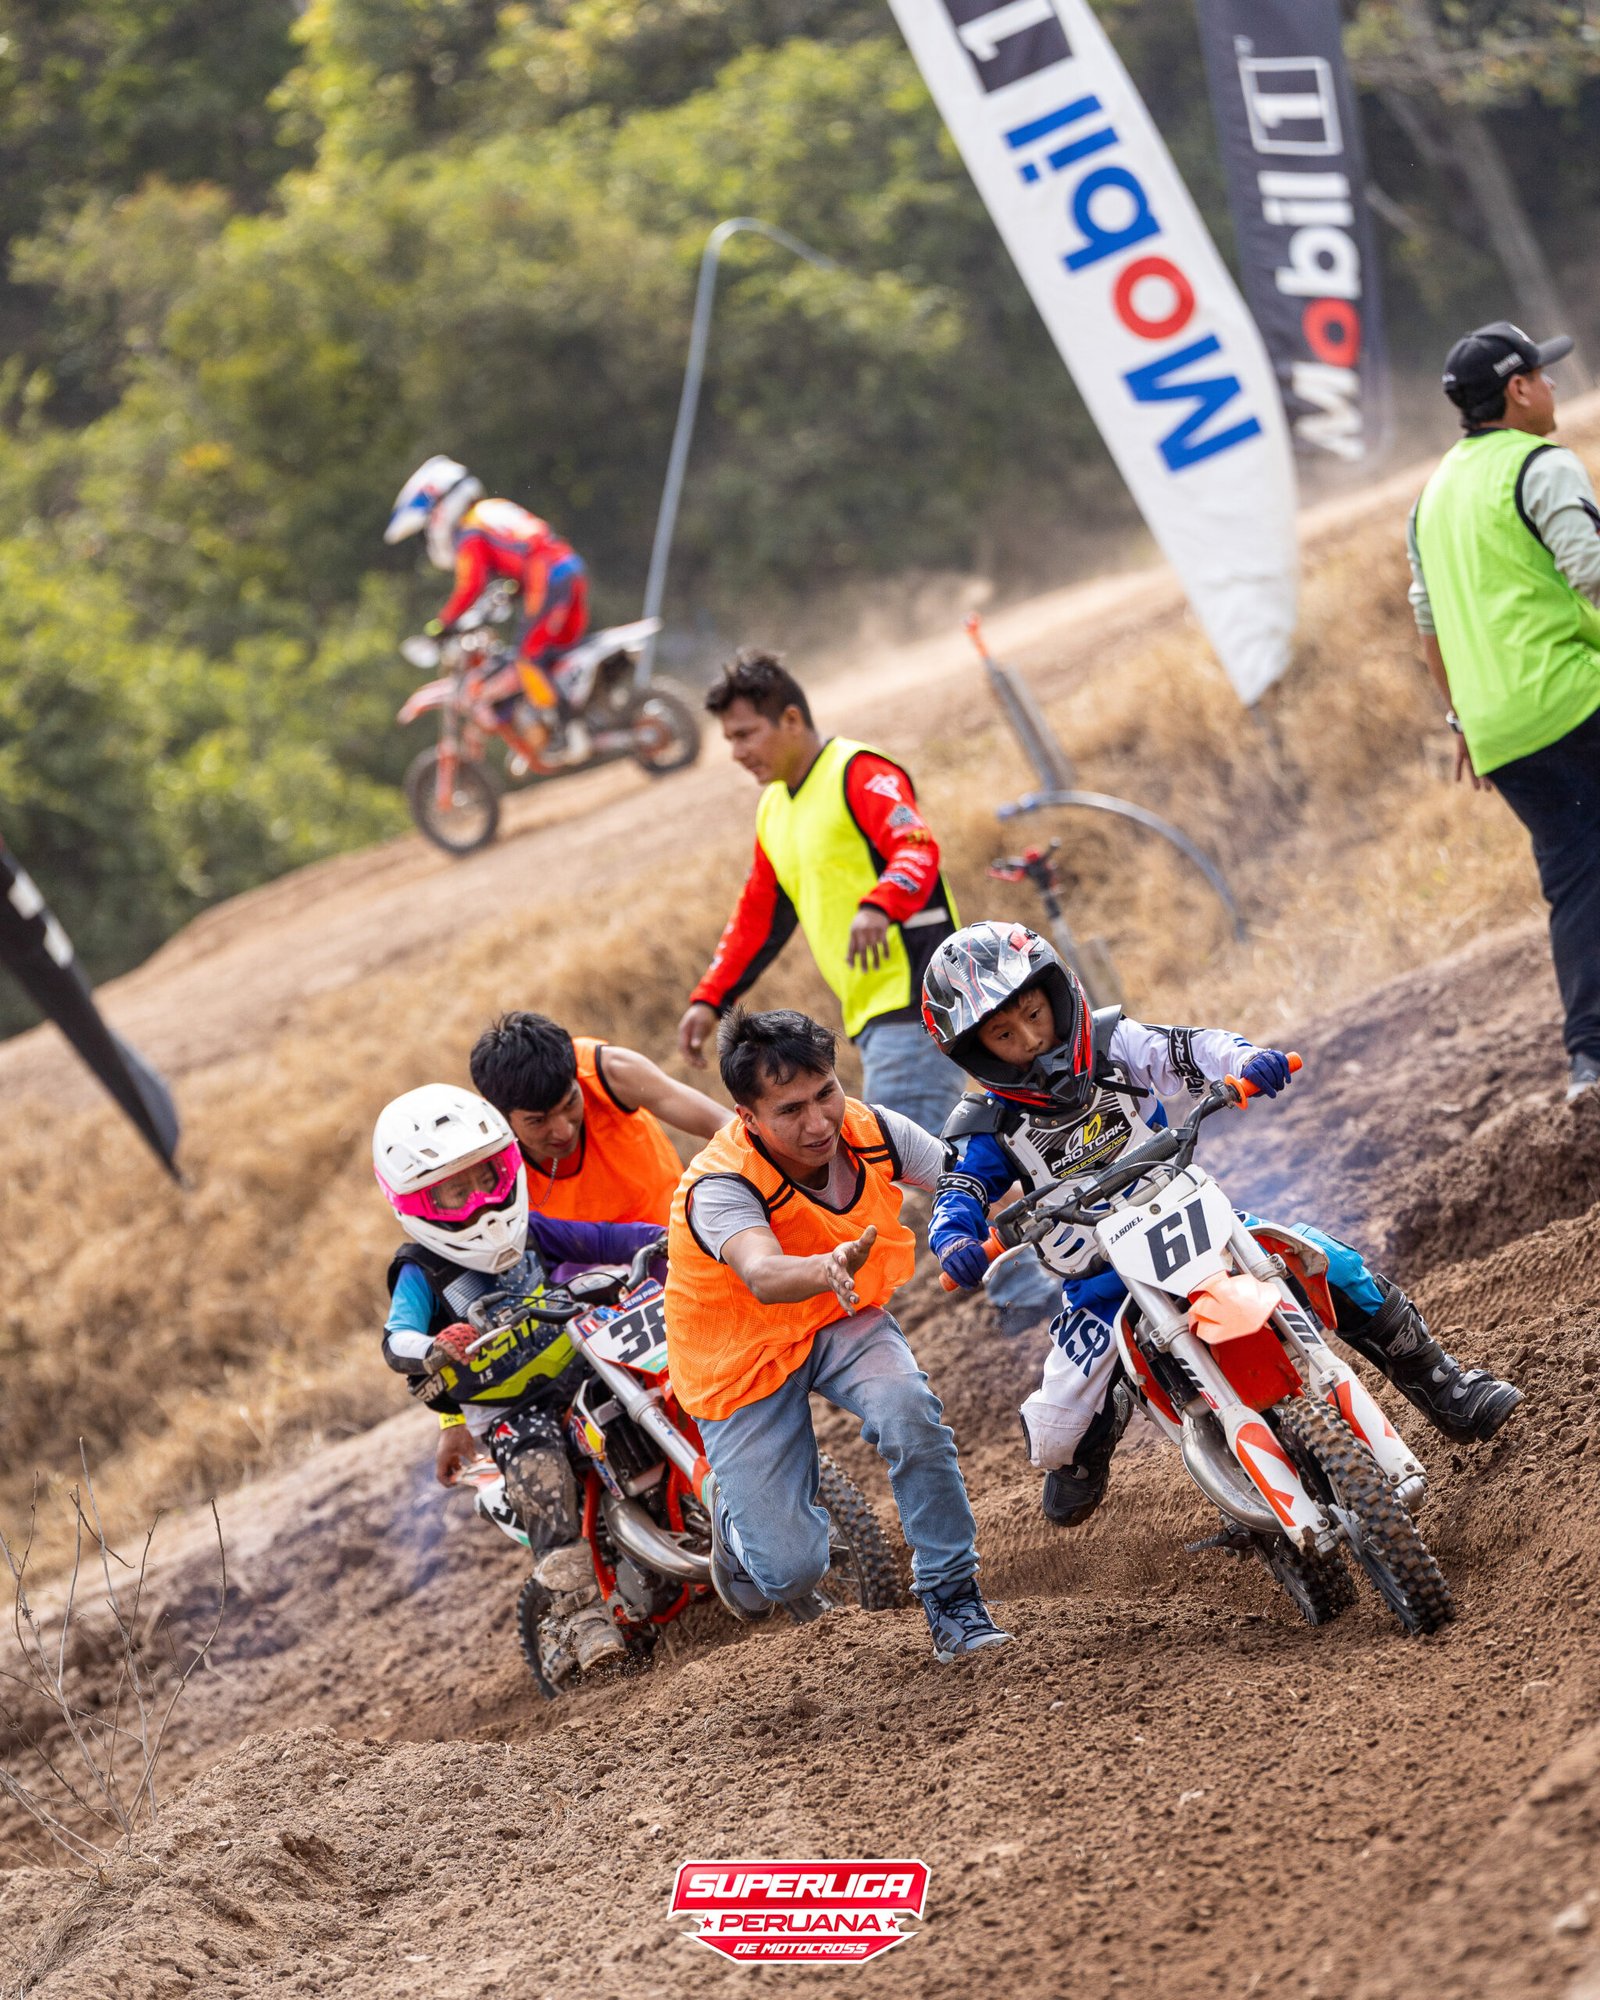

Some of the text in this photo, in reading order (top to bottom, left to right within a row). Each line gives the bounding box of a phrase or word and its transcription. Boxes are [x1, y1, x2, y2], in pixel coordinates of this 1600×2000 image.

[1004, 95, 1262, 473] Mobil
[1258, 171, 1363, 461] Mobil
[1051, 1121, 1126, 1172] PRO TORK
[1144, 1198, 1212, 1283] 61
[479, 1370, 494, 1385] 1.5
